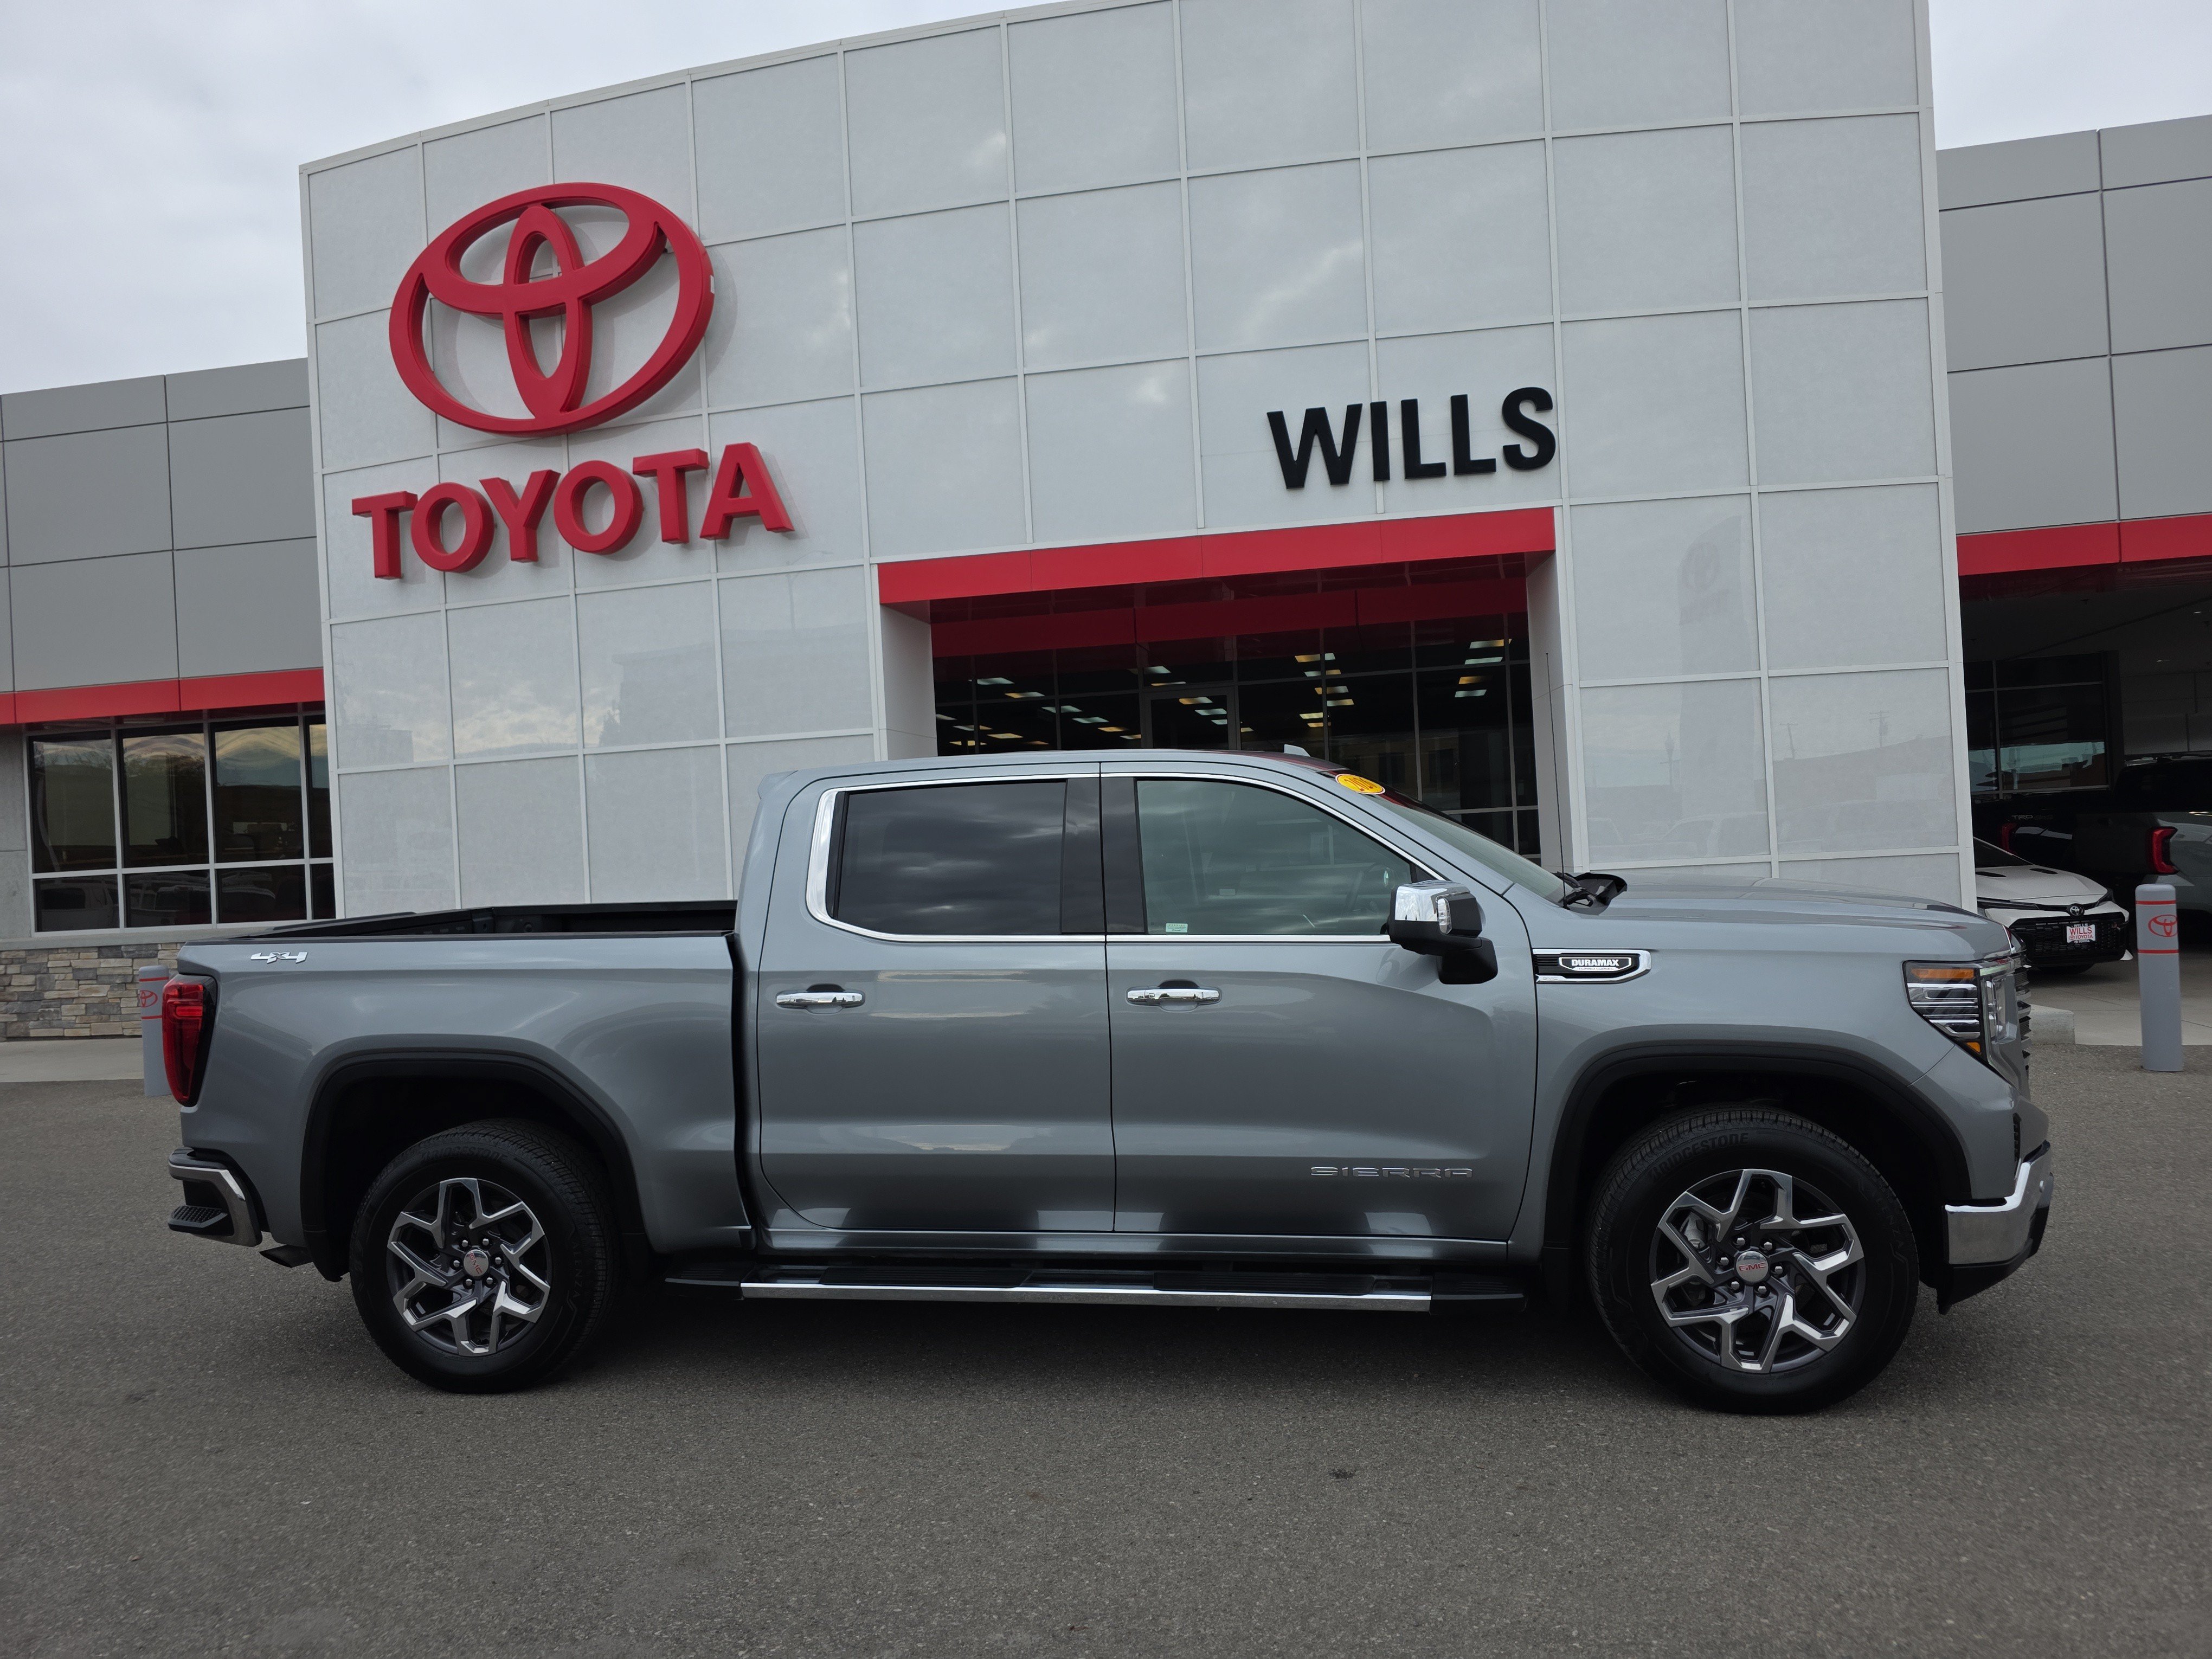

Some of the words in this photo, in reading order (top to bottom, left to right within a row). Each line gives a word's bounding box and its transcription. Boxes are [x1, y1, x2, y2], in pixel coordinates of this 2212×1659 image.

[1266, 387, 1556, 489] WILLS
[352, 442, 795, 581] TOYOTA
[1311, 1167, 1472, 1178] SIERRA
[1647, 1133, 1749, 1180] BRIDGESTONE
[470, 1252, 483, 1274] GMC
[1739, 1262, 1766, 1271] GMC
